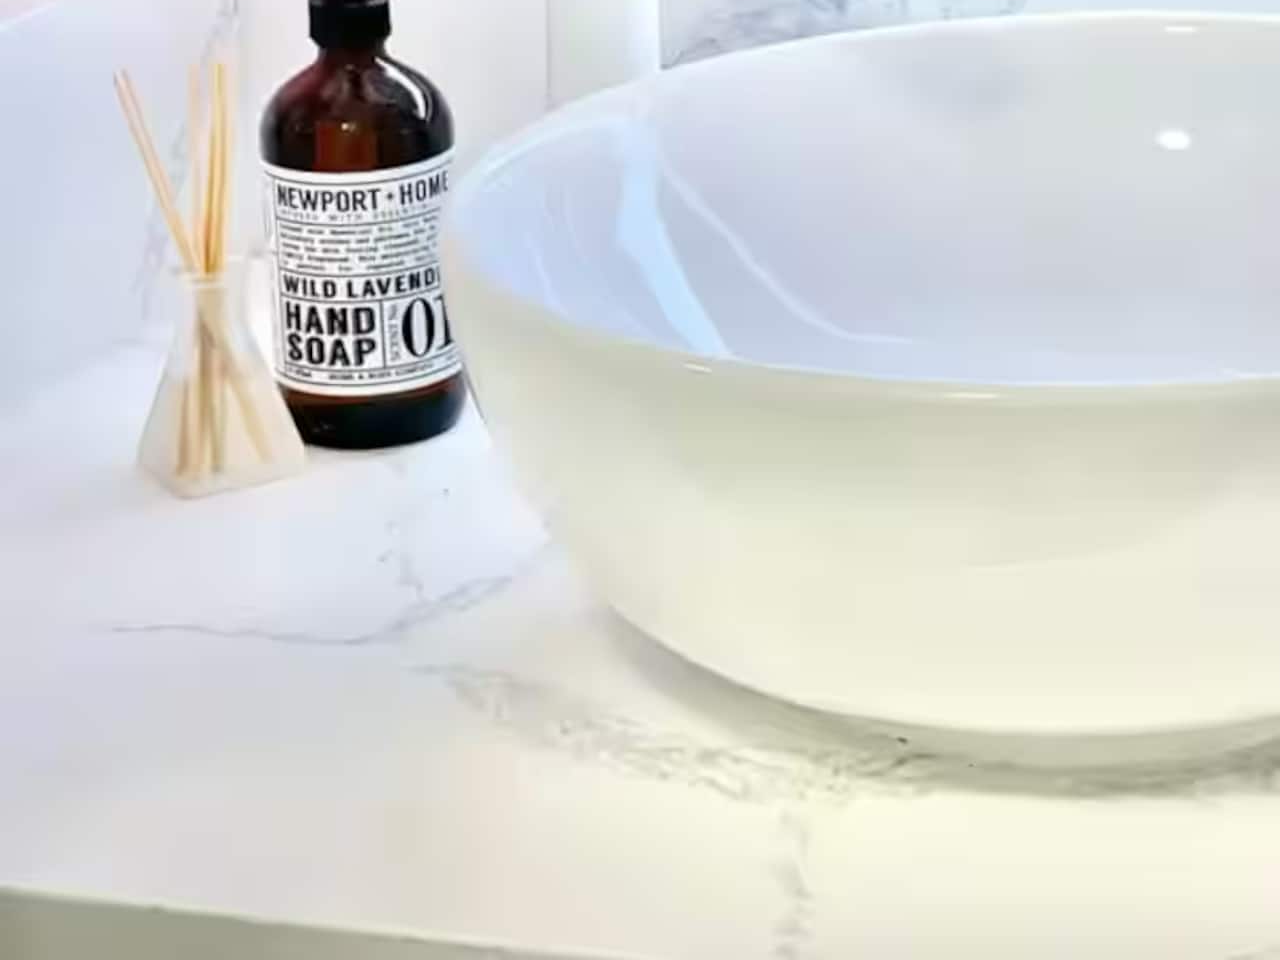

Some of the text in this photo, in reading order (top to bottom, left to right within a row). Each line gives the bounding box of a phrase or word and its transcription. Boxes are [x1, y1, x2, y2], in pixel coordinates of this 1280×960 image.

[277, 183, 382, 213] NEWPORT
[398, 170, 449, 205] HOME
[283, 266, 441, 299] WILD LAVEND
[285, 300, 377, 336] HAND
[402, 294, 454, 358] 01
[287, 333, 377, 367] SOAP
